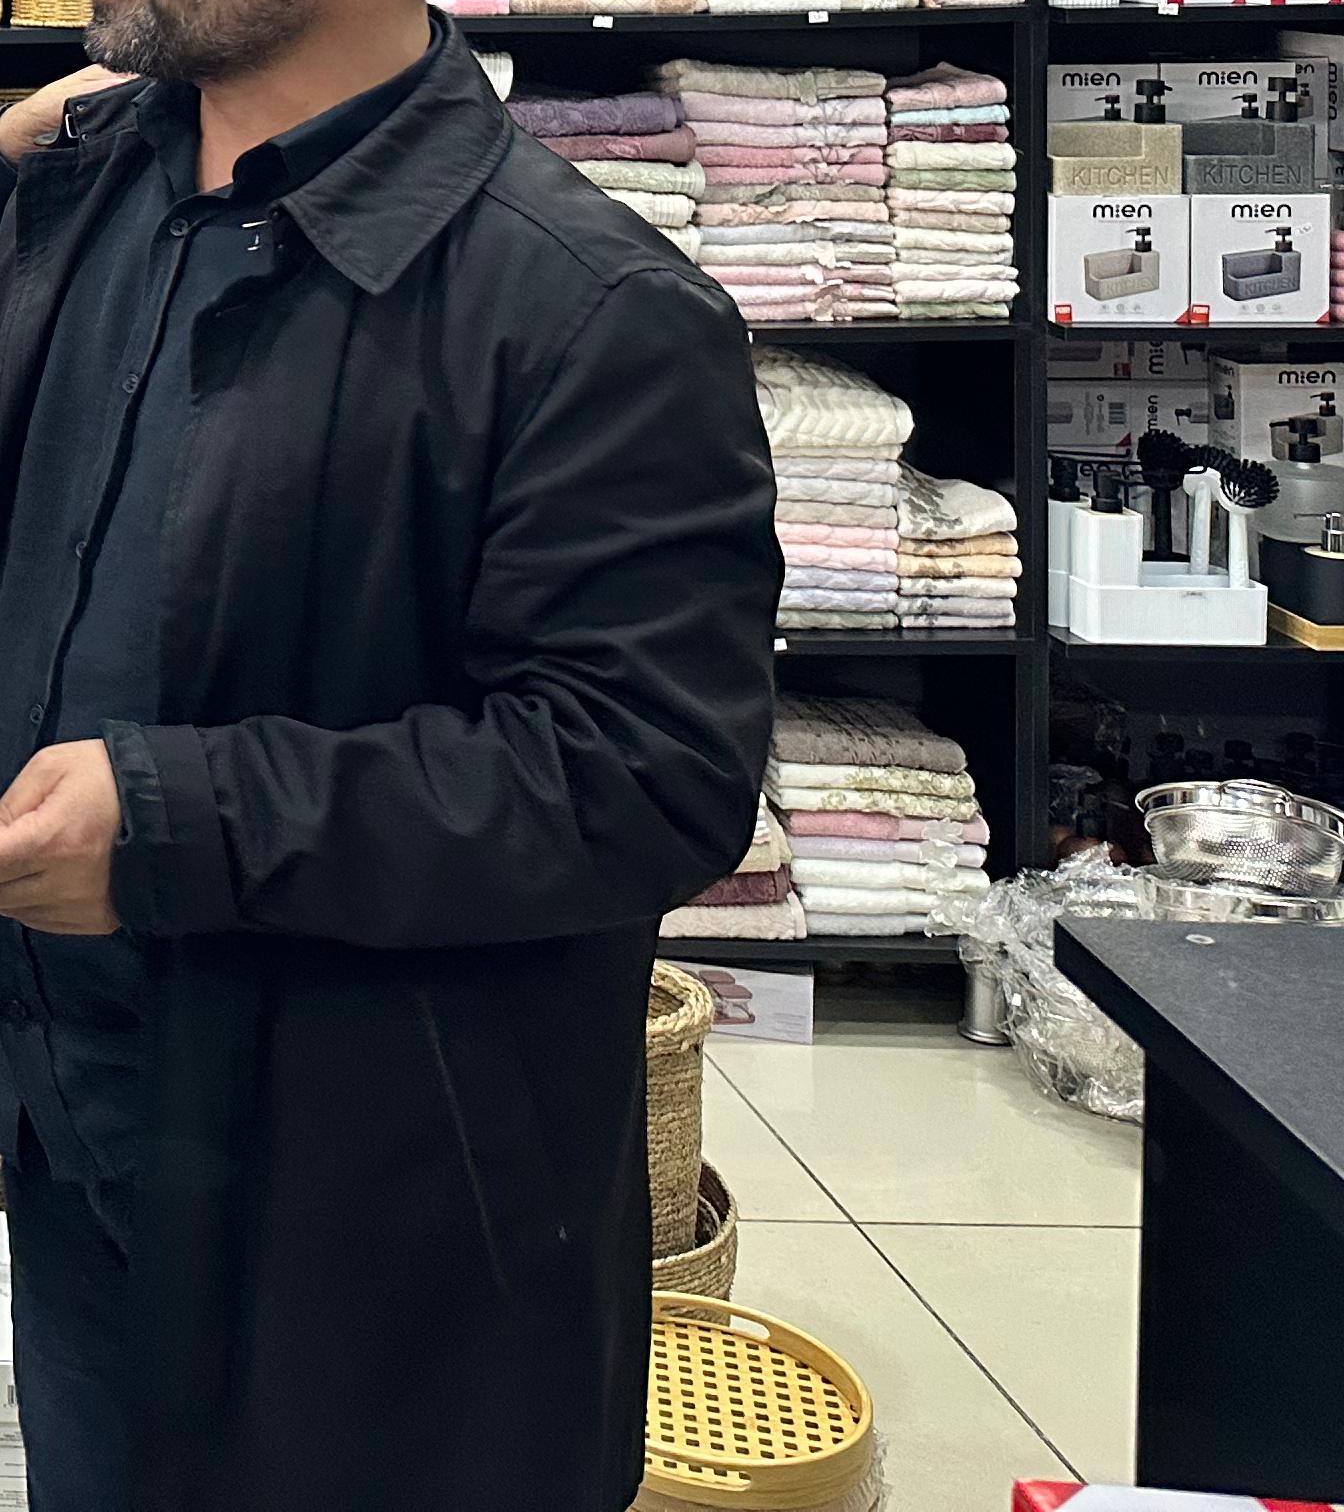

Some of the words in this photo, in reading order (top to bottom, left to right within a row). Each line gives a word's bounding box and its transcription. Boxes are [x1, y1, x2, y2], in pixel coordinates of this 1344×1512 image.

[1062, 71, 1121, 87] mien
[1198, 70, 1258, 86] mien
[1072, 165, 1169, 186] KITCHEN
[1203, 165, 1301, 185] KITCHEN
[1092, 203, 1152, 218] mien
[1231, 203, 1292, 218] mien
[1278, 370, 1336, 384] mien
